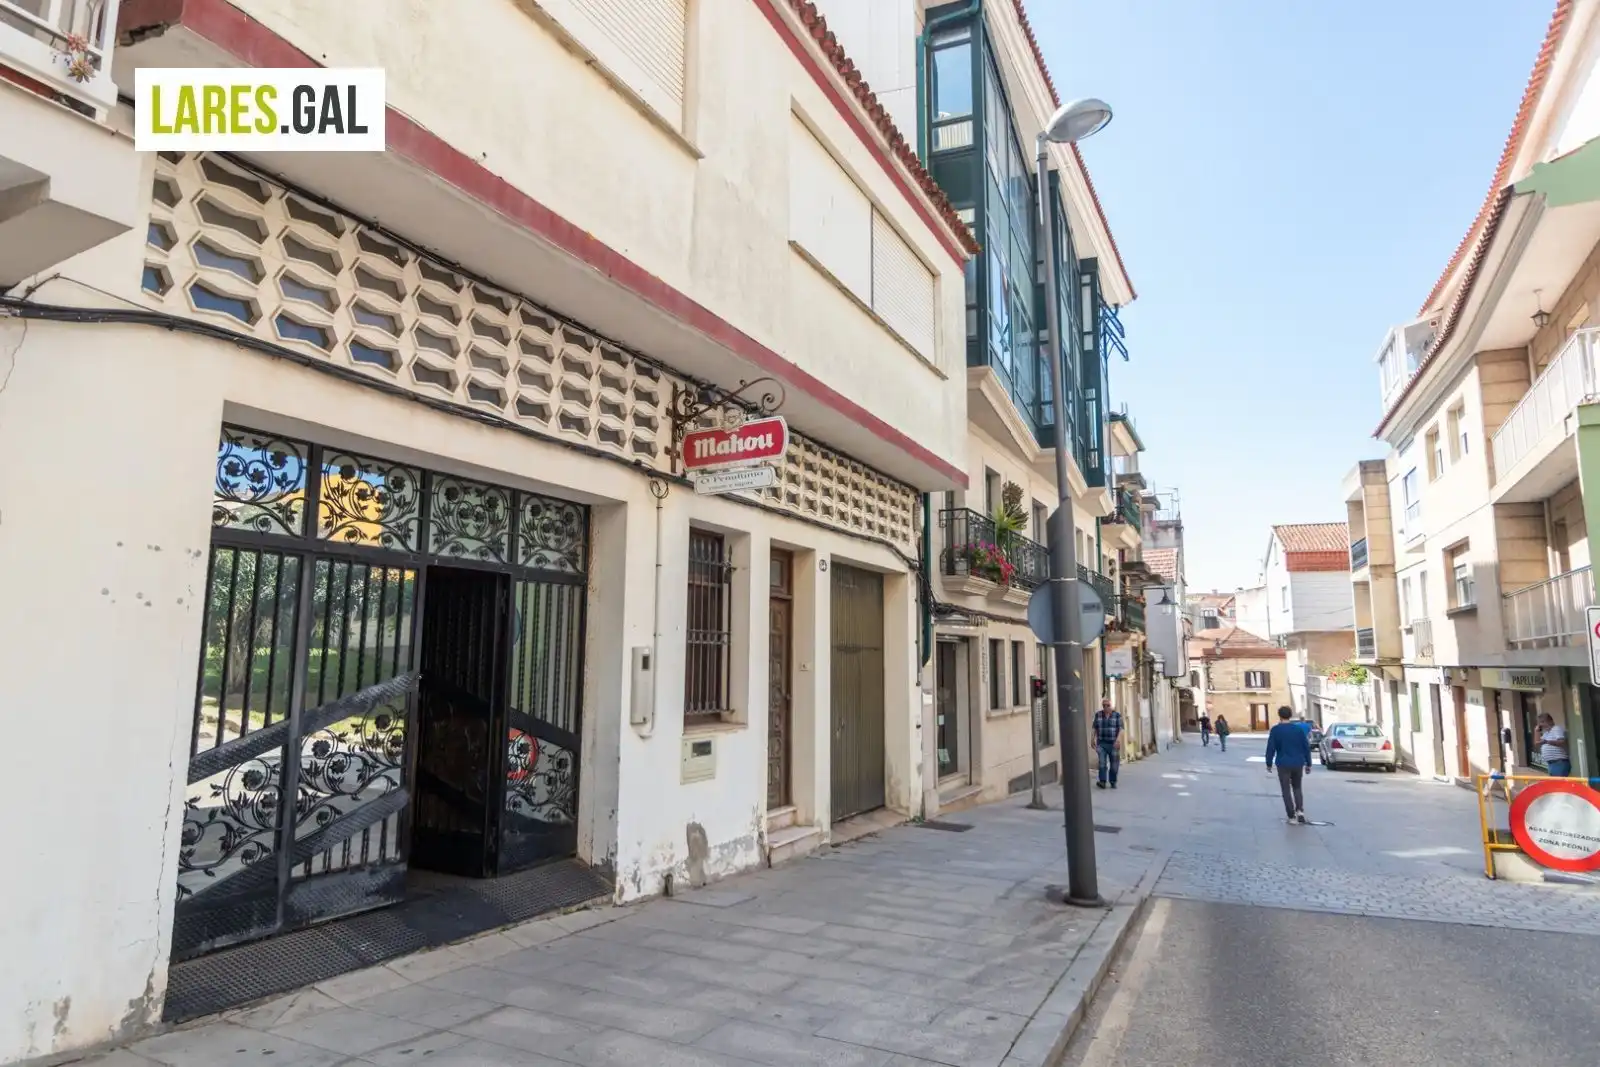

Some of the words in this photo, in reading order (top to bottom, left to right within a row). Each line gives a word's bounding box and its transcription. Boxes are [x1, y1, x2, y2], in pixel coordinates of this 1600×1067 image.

[695, 433, 774, 458] Mahou
[1549, 829, 1600, 842] AUTORIZADOS
[1538, 838, 1560, 847] ZONA
